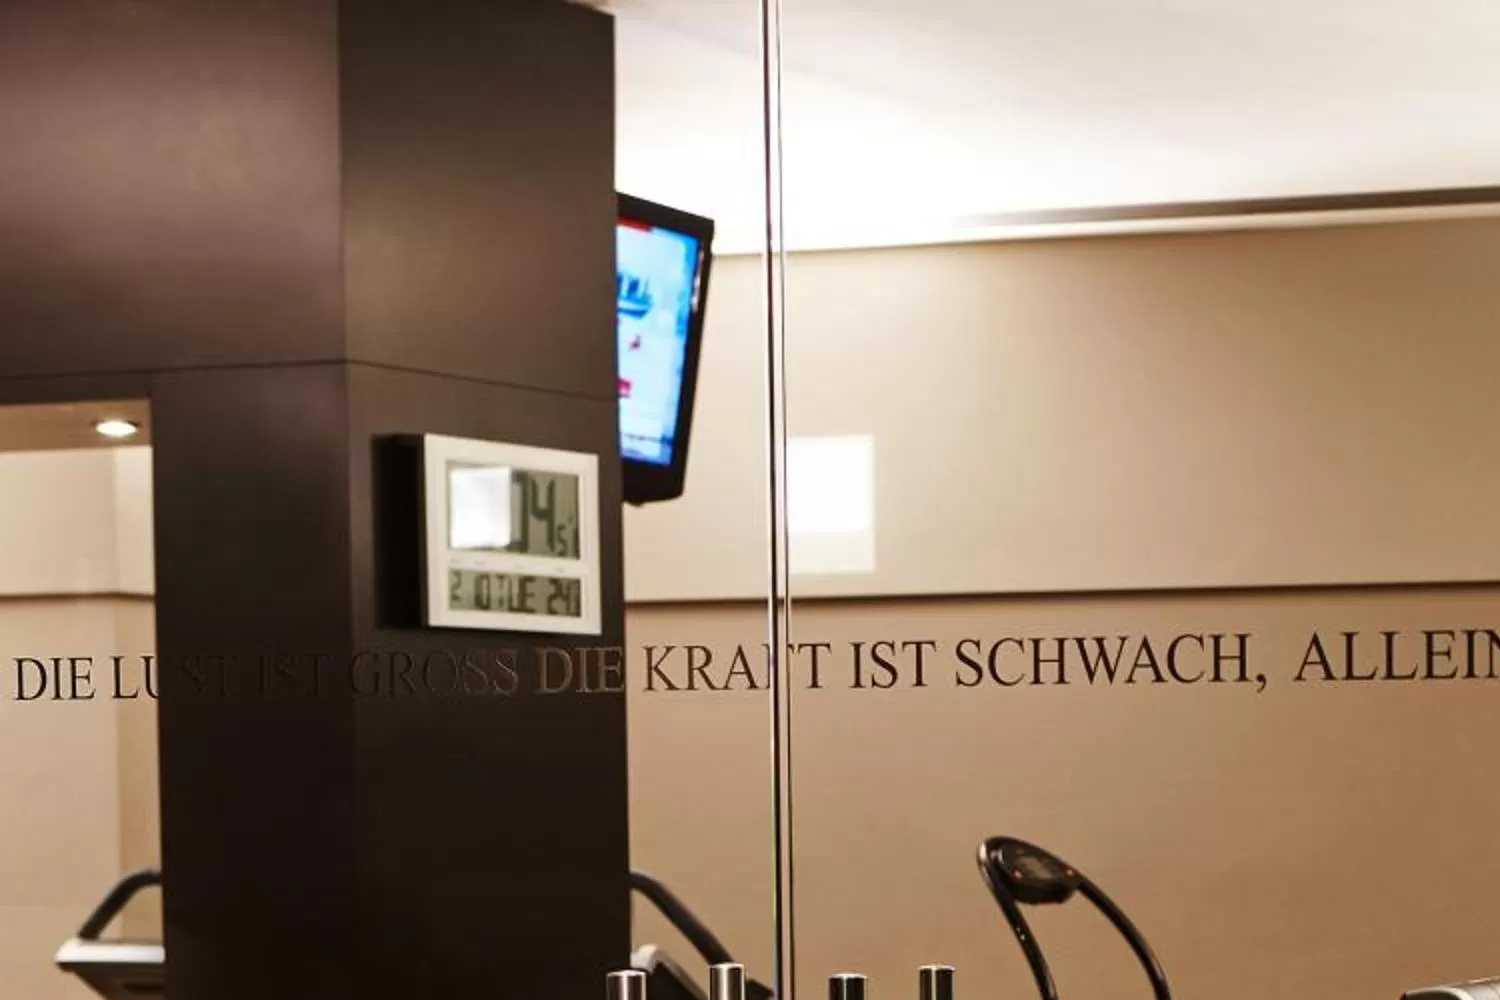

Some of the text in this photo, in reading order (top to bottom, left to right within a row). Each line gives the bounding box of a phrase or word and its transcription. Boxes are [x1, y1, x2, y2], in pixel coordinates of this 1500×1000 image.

[13, 656, 96, 701] DIE
[346, 647, 520, 697] GROSS
[535, 645, 626, 694] DIE
[849, 640, 937, 689] IST
[955, 633, 1268, 694] SCHWACH,
